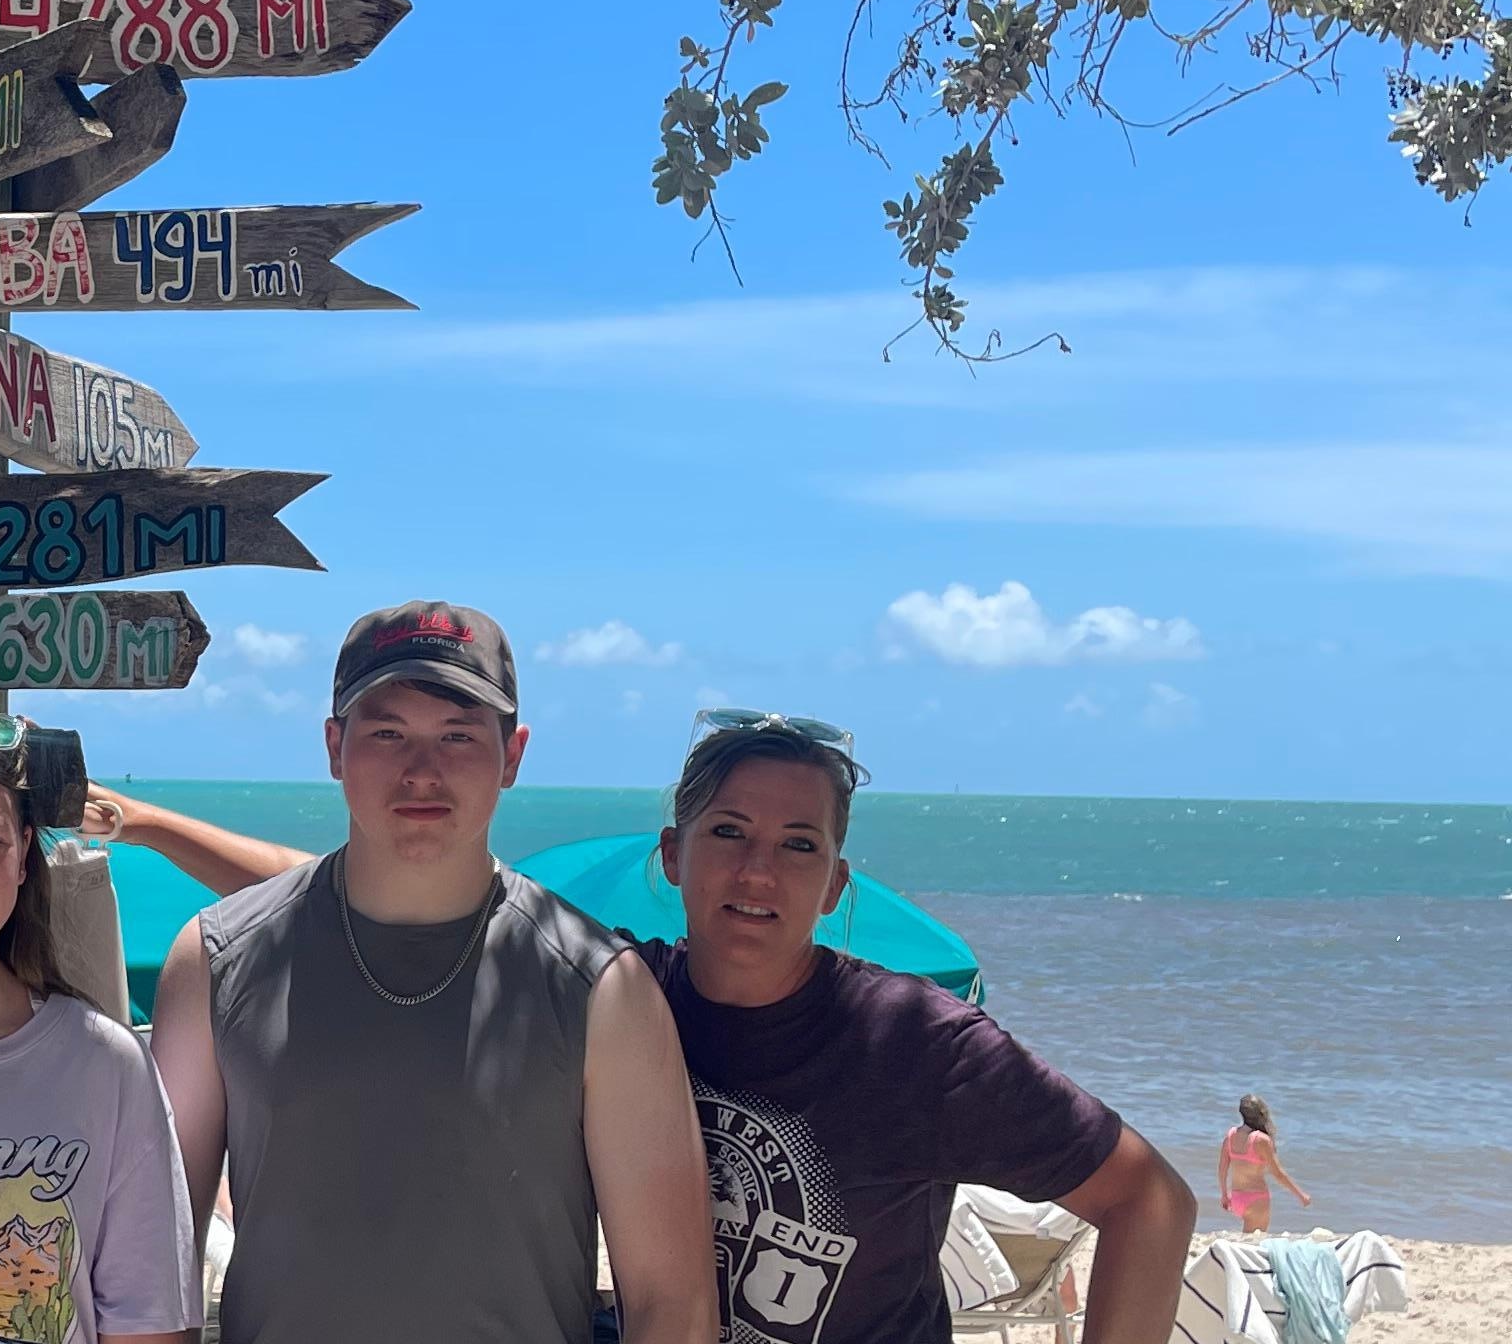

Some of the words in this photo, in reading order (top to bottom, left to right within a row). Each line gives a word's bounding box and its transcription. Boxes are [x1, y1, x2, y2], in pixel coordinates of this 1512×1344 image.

[113, 211, 238, 303] 494
[244, 247, 303, 298] mi
[72, 363, 143, 469] 105
[142, 432, 174, 469] MI
[133, 504, 226, 572] MI
[115, 617, 178, 684] MI
[716, 1106, 792, 1186] WEST
[718, 1144, 758, 1202] SCENIC
[771, 1221, 845, 1257] END
